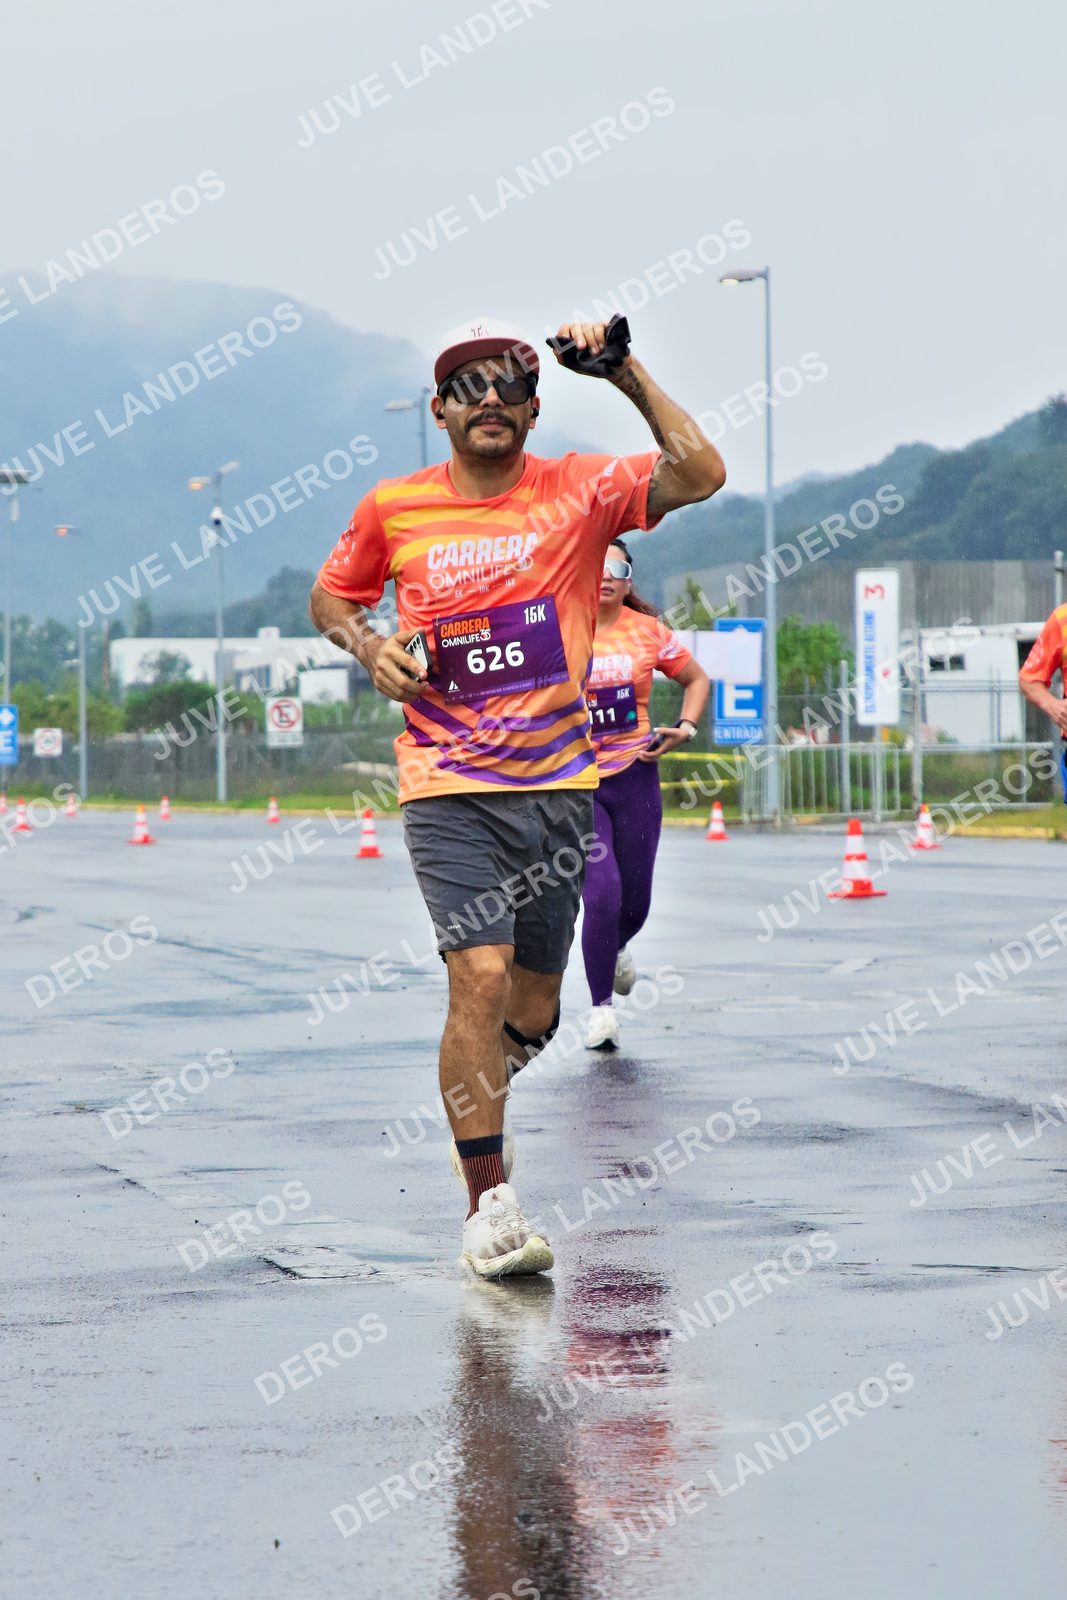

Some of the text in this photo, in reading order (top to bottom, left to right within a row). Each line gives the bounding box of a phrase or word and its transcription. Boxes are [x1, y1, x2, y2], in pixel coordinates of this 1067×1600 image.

[427, 532, 538, 570] CARRERA
[864, 584, 885, 600] 3
[524, 604, 546, 624] 15K
[441, 616, 490, 638] CARRERA
[466, 641, 525, 674] 626
